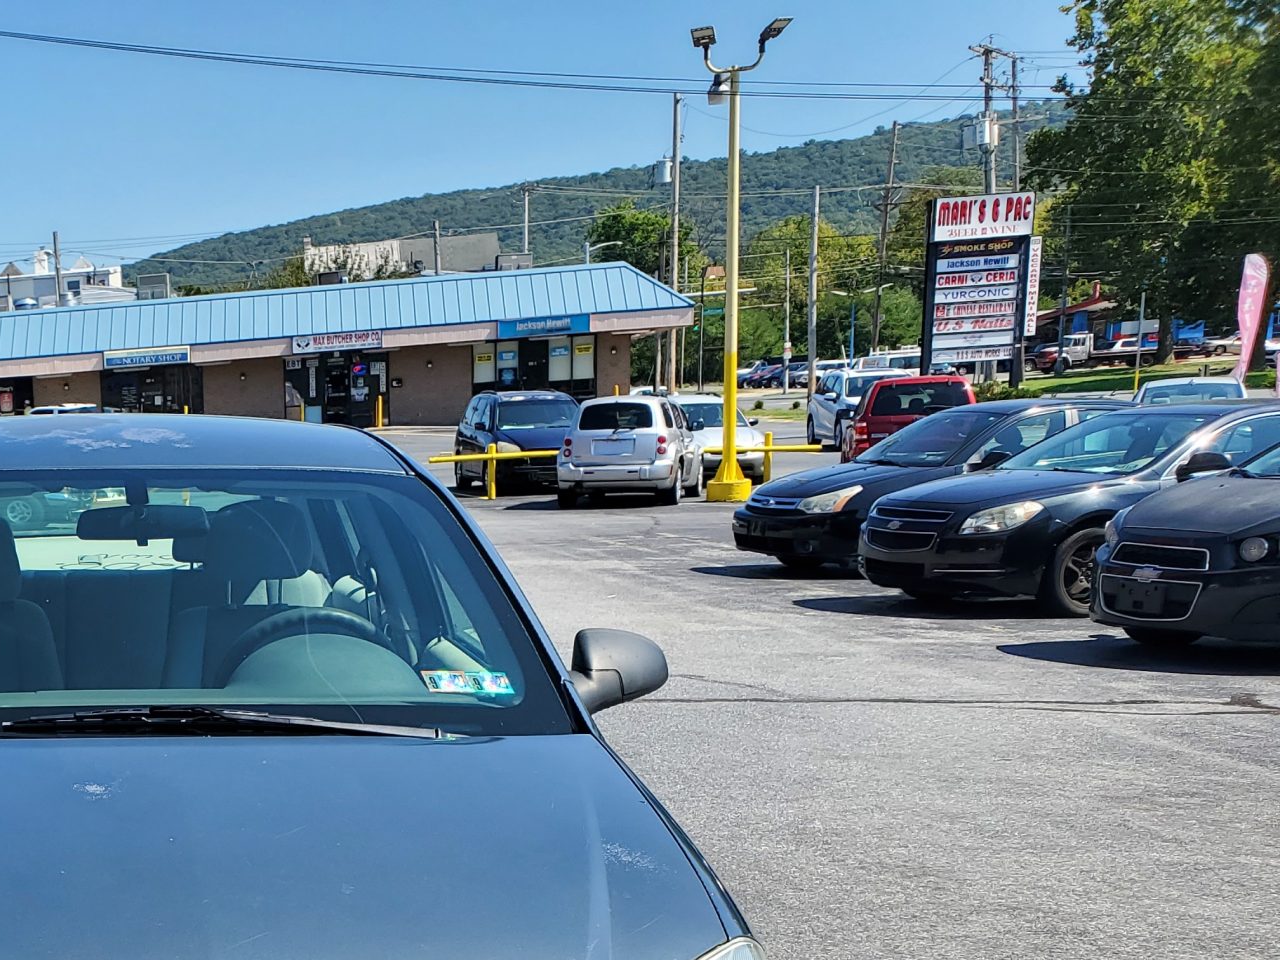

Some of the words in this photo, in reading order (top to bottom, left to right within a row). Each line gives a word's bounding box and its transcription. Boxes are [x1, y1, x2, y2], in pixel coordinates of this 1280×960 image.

[937, 199, 987, 226] MARI'S
[992, 198, 1000, 222] 6
[1005, 195, 1031, 222] PAC
[947, 226, 978, 238] BEER
[990, 225, 1019, 234] WINE
[953, 243, 985, 252] SMOKE
[987, 241, 1014, 251] SHOP
[947, 258, 980, 269] Jackson
[937, 274, 968, 286] CARNI
[985, 271, 1016, 282] CERIA
[942, 288, 1010, 300] YURCONIC
[953, 304, 976, 315] CHINESE
[978, 301, 1015, 313] RESTAURANT
[516, 320, 546, 331] Jackson
[546, 317, 571, 329] Hewitt
[970, 318, 1012, 330] Nails
[1026, 312, 1035, 333] MALL
[327, 333, 353, 344] BUTCHER
[354, 332, 369, 342] SHOP
[122, 355, 156, 365] NOTARY
[158, 353, 182, 362] SHOP
[429, 676, 439, 689] 9
